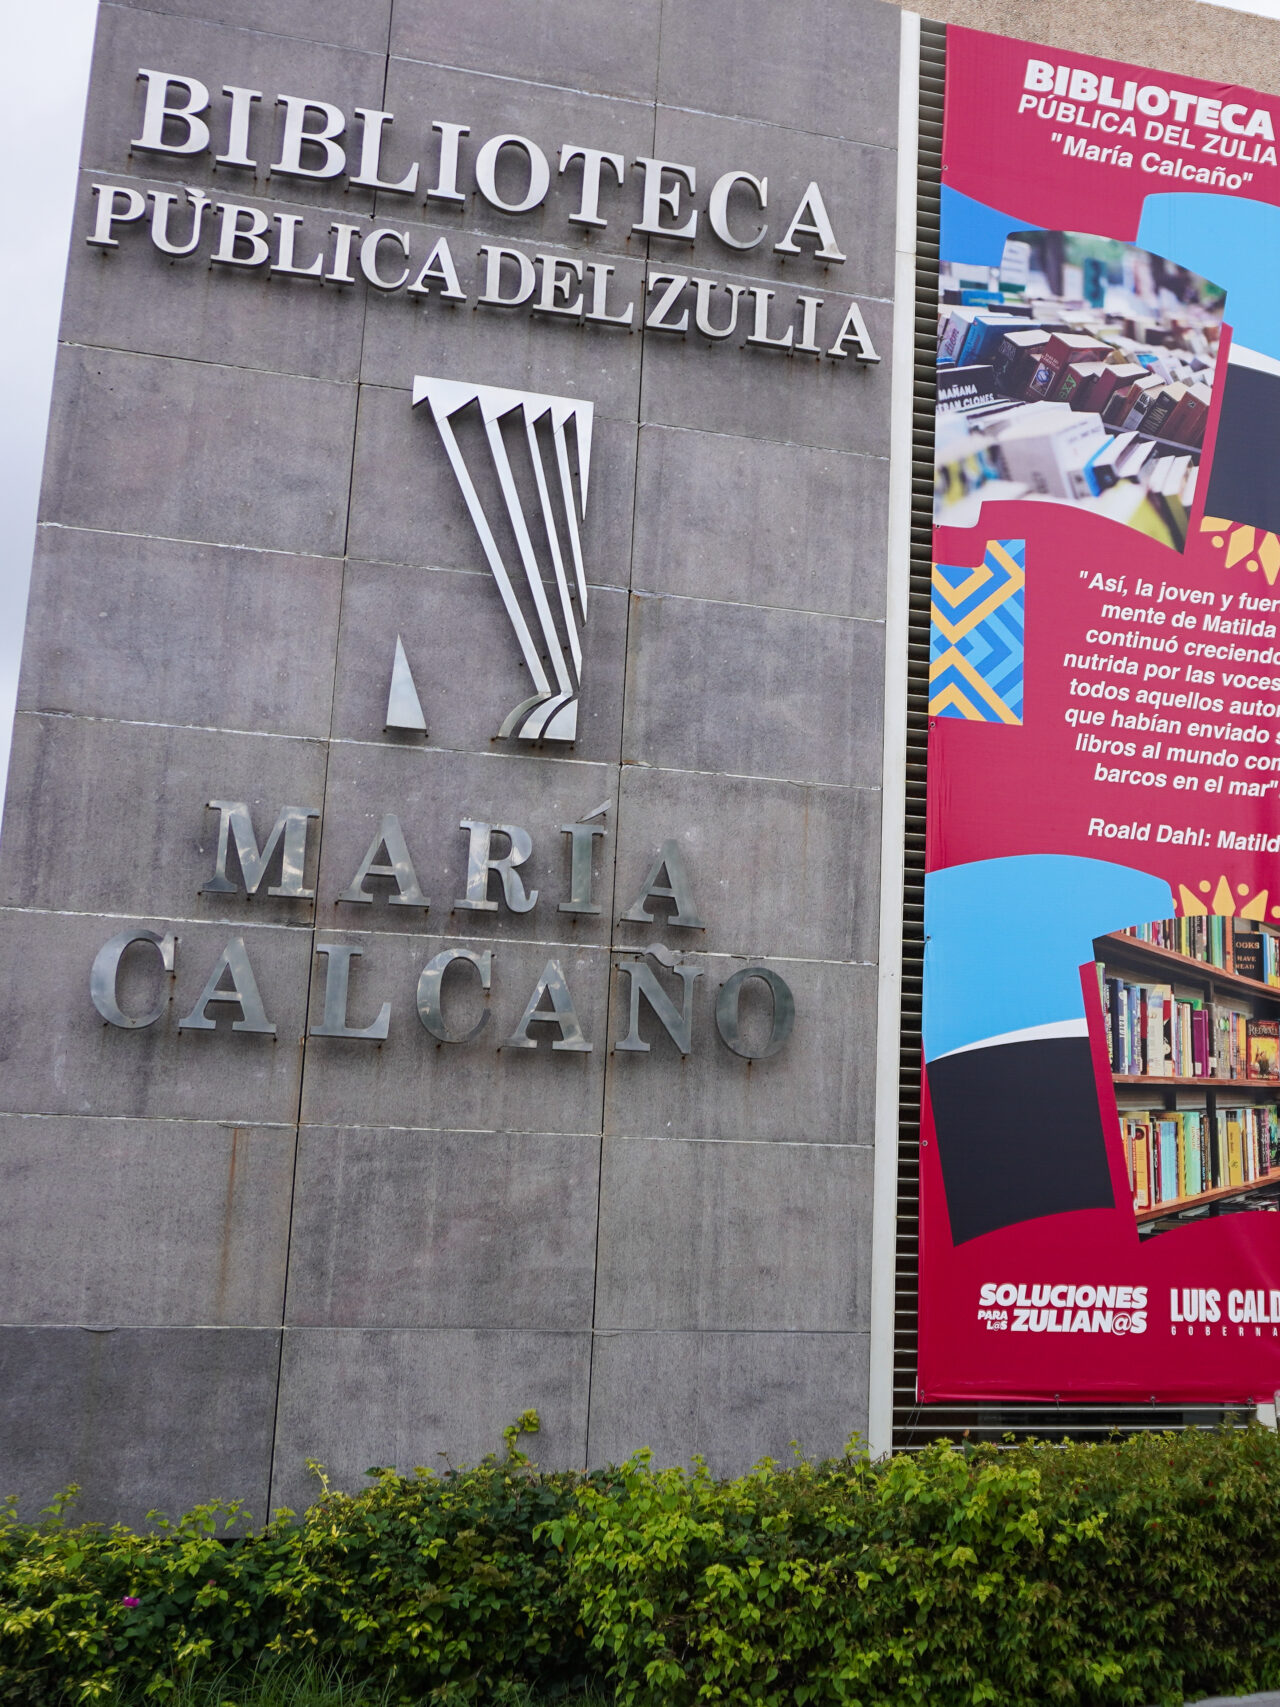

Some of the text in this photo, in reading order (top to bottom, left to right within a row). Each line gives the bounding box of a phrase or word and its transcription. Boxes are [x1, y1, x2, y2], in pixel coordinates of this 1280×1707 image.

[1024, 59, 1276, 141] BIBLIOTECA
[1017, 94, 1278, 166] PÚBLICA DEL ZULIA
[131, 68, 846, 265] BIBLIOTECA
[1050, 132, 1254, 190] "María Calcaño"
[477, 244, 635, 329] DEL
[643, 271, 882, 365] ZULIA
[1079, 570, 1129, 596] "Así,
[1135, 578, 1154, 597] la
[1157, 581, 1216, 606] joven
[1220, 593, 1234, 610] y
[1101, 602, 1278, 639] mente de Matilda
[1085, 628, 1179, 654] continuó
[1063, 652, 1139, 676] nutrida
[1143, 662, 1181, 681] por
[1185, 665, 1216, 685] las
[1069, 678, 1130, 701] todos
[1135, 688, 1224, 713] aquellos
[1064, 707, 1106, 727] que
[1110, 710, 1182, 735] habían
[1187, 721, 1270, 744] enviado
[1075, 733, 1137, 757] libros
[1141, 742, 1161, 759] al
[1166, 744, 1239, 769] mundo
[1094, 763, 1167, 788] barcos
[1173, 774, 1199, 791] en
[1204, 775, 1223, 794] el
[1087, 817, 1151, 841] Roald
[1156, 824, 1212, 847] Dahl:
[200, 799, 706, 931] MARÍA
[90, 928, 796, 1061] CALCAÑO
[979, 1283, 1148, 1309] SOLUCIONES
[1170, 1288, 1221, 1323] LUIS
[977, 1309, 1008, 1321] PARA
[986, 1308, 1148, 1336] L@S ZULIAN@S
